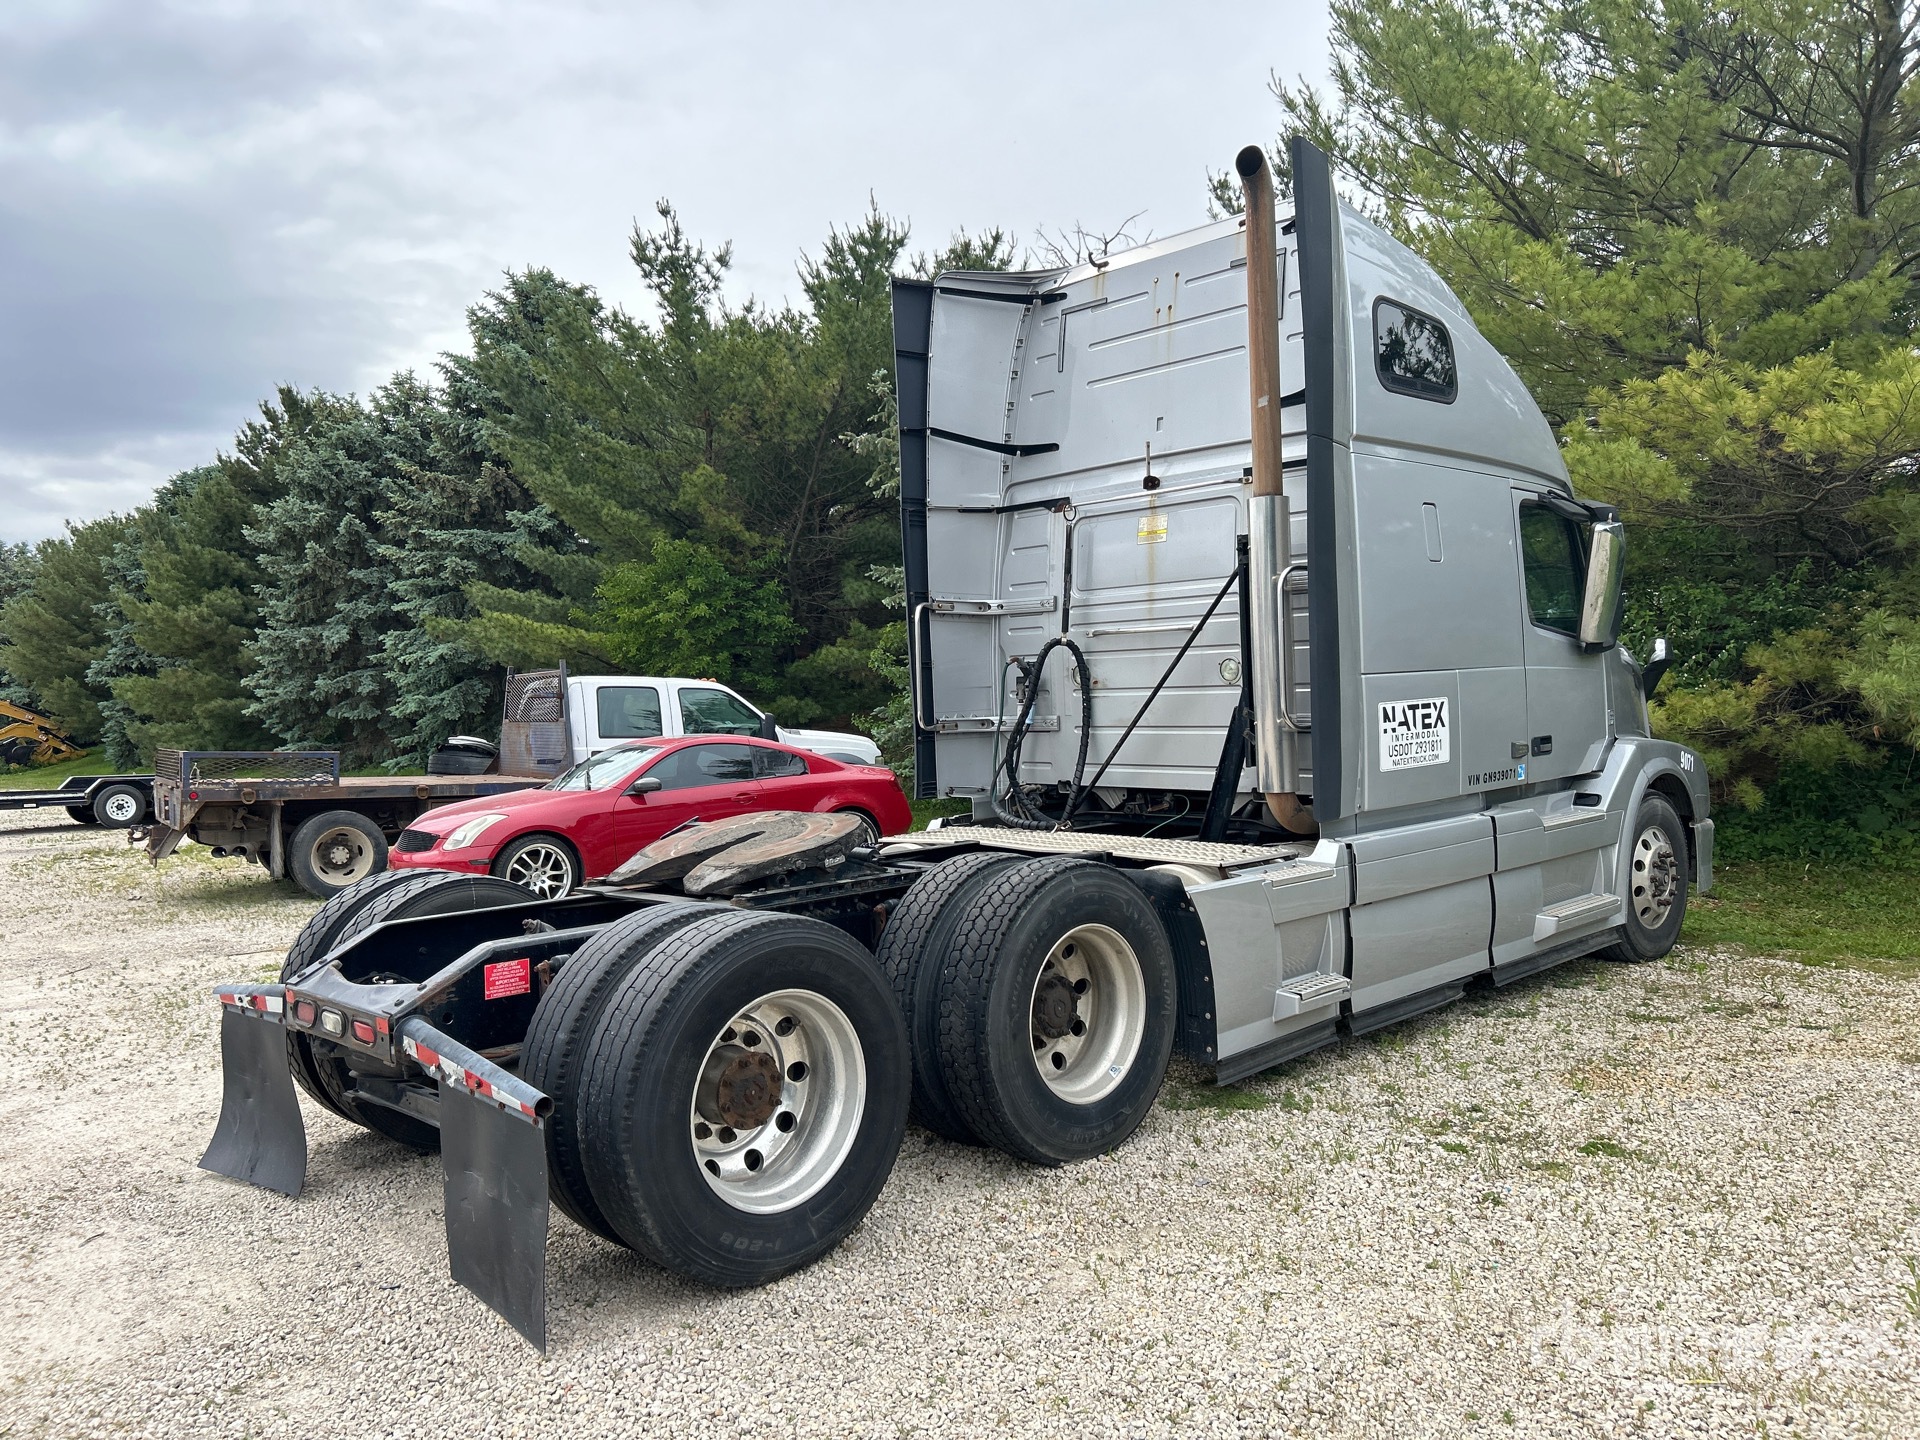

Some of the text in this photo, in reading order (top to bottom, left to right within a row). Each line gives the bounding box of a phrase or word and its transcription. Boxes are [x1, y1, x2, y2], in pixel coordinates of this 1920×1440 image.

[1382, 701, 1446, 734] NATEX
[1391, 730, 1440, 742] INTERMODAL
[1388, 739, 1442, 757] USDOT 2931811
[1392, 754, 1440, 767] NATEXTRUCK.COM
[1680, 750, 1694, 772] 9071
[1468, 768, 1516, 786] VIN GN939071
